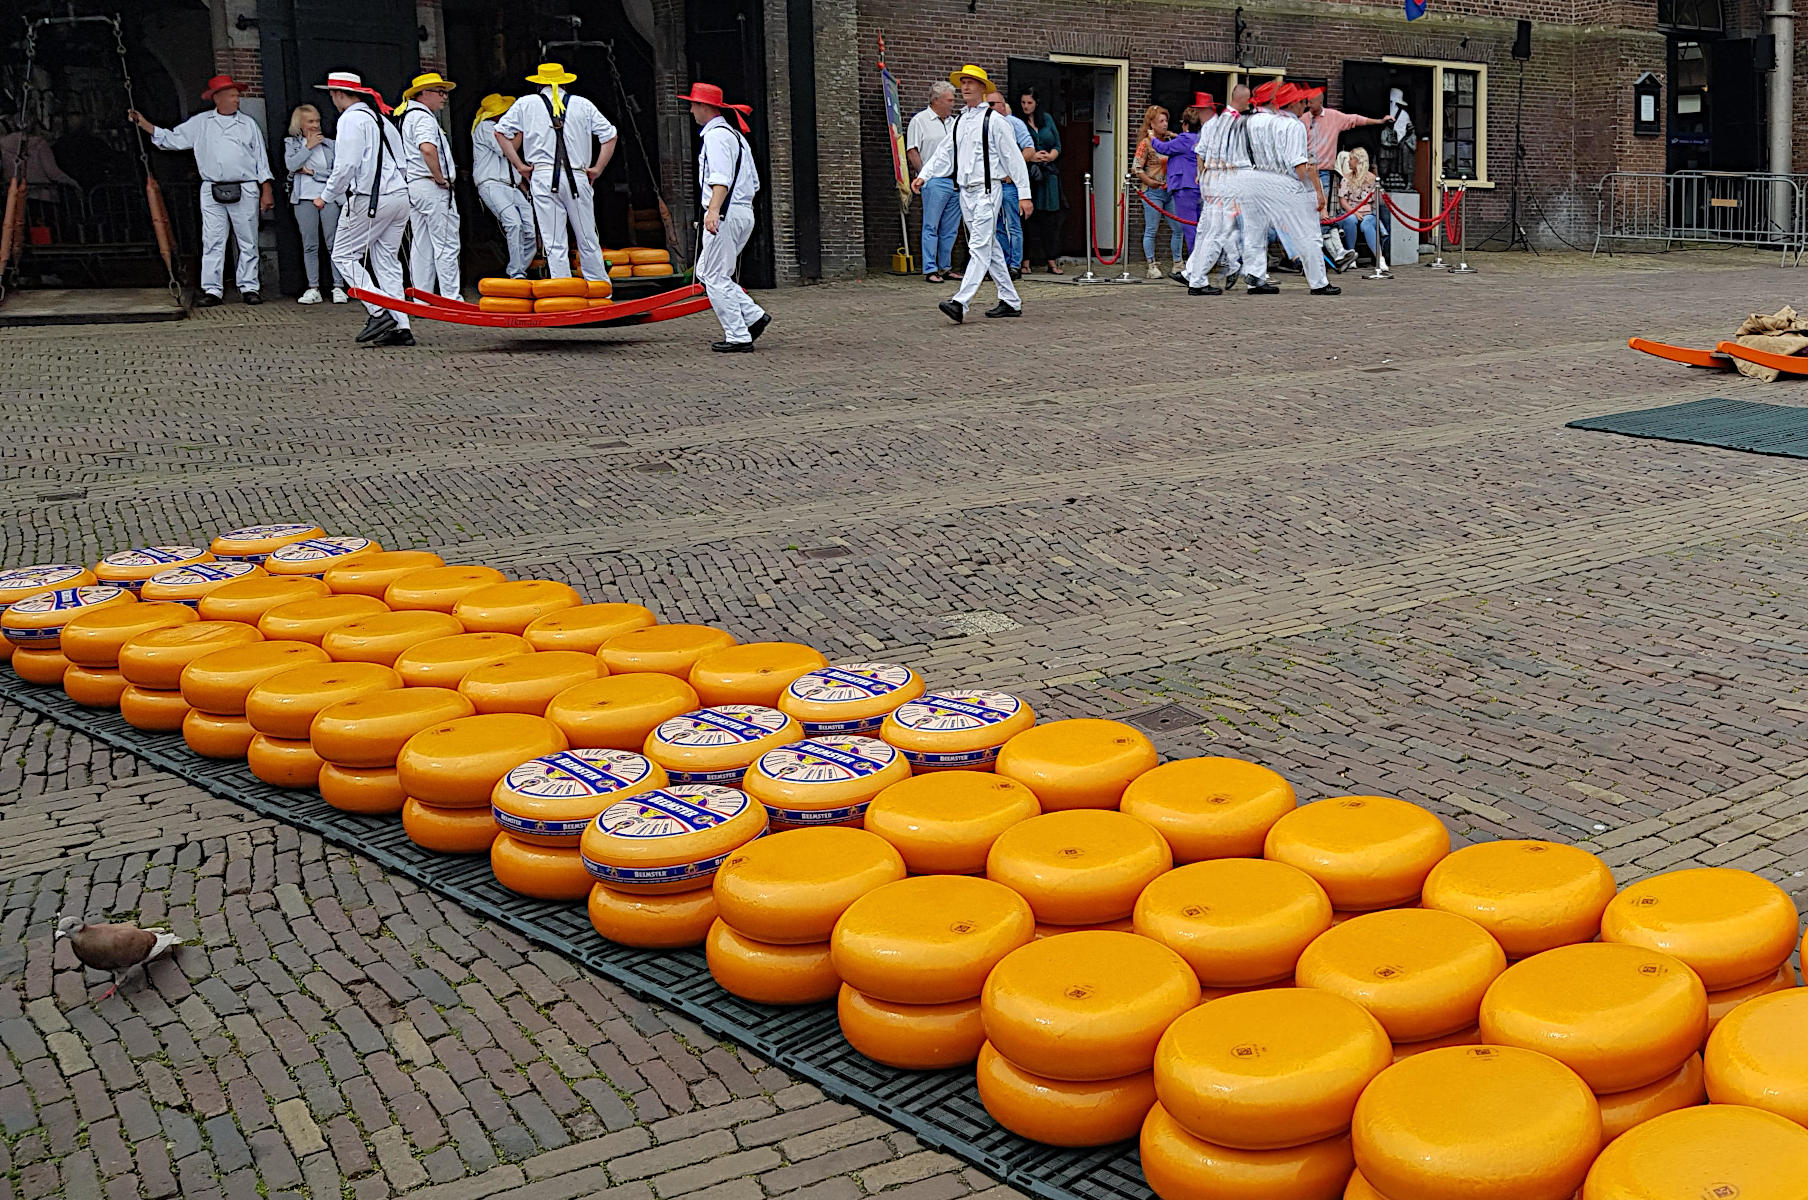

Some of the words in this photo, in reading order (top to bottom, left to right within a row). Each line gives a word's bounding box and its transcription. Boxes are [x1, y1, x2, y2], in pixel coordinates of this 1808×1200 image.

[698, 713, 747, 730] BEEMSTER
[800, 745, 856, 763] BEEMSTER
[555, 758, 602, 780] BEEMSTER
[648, 796, 700, 817] BEEMSTER
